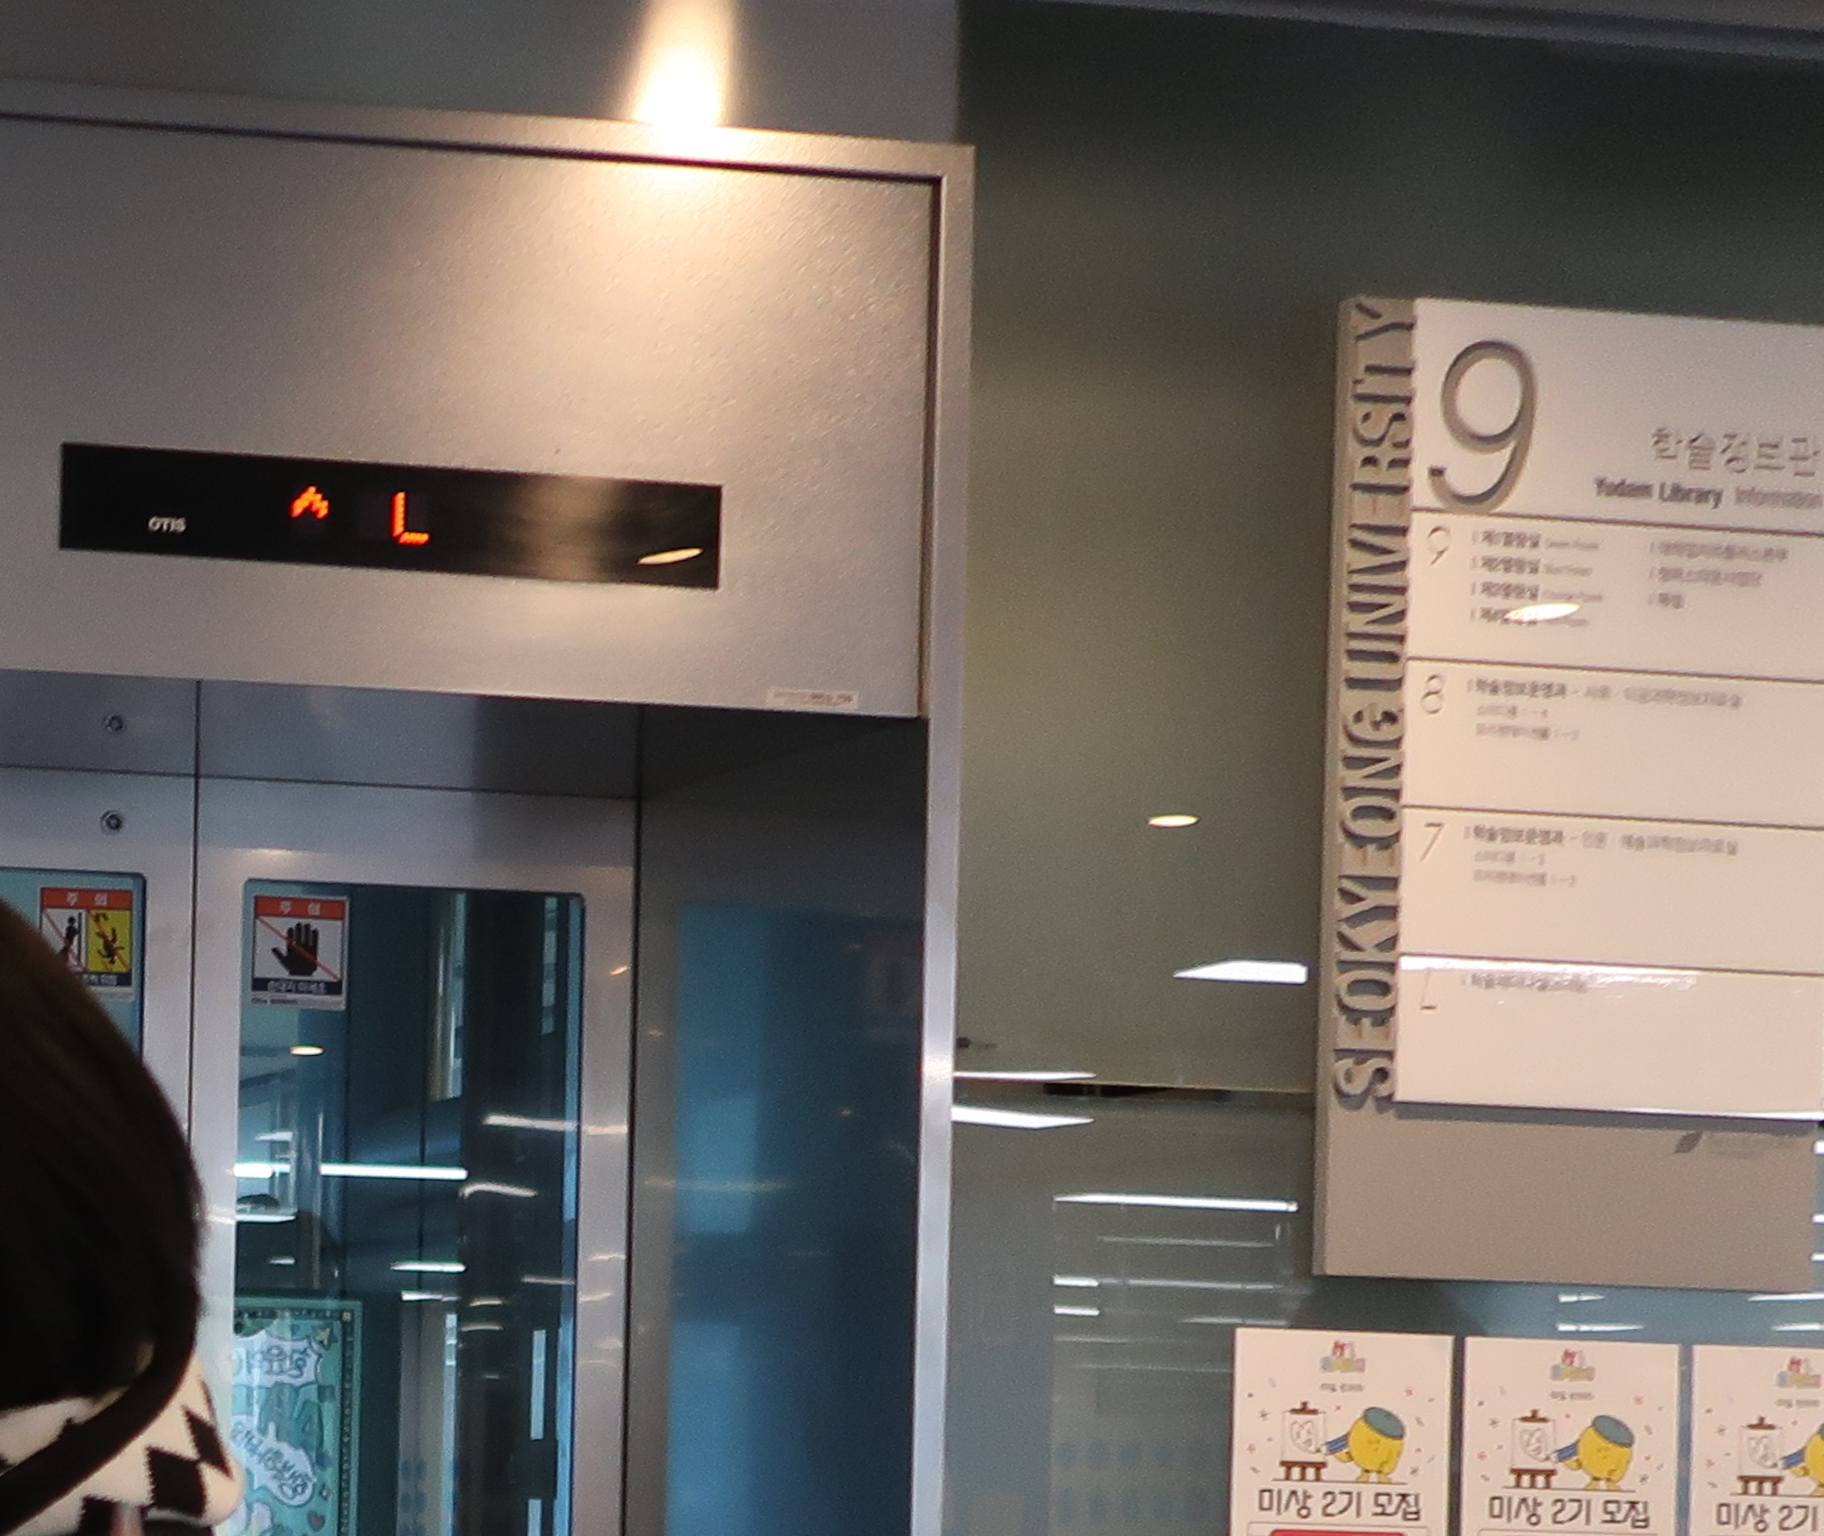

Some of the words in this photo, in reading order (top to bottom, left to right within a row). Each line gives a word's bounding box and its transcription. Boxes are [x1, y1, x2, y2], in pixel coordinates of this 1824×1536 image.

[1427, 340, 1539, 514] 9
[1342, 301, 1416, 692] UNIVERSITY
[1658, 482, 1724, 510] Library
[147, 515, 188, 534] OTIS
[392, 490, 431, 546] L
[1427, 525, 1451, 566] 9
[1420, 673, 1446, 715] 8
[1420, 822, 1445, 862] 7
[1331, 702, 1406, 1104] SEOKYEONG
[1258, 1488, 1313, 1519] 미상
[1321, 1490, 1362, 1519] 2기
[1371, 1492, 1422, 1522] 모집
[1488, 1495, 1544, 1527] 미상
[1551, 1499, 1592, 1527] 2기
[1600, 1500, 1650, 1530] 모집
[1715, 1502, 1768, 1533] 미상
[1778, 1505, 1819, 1533] 2기
